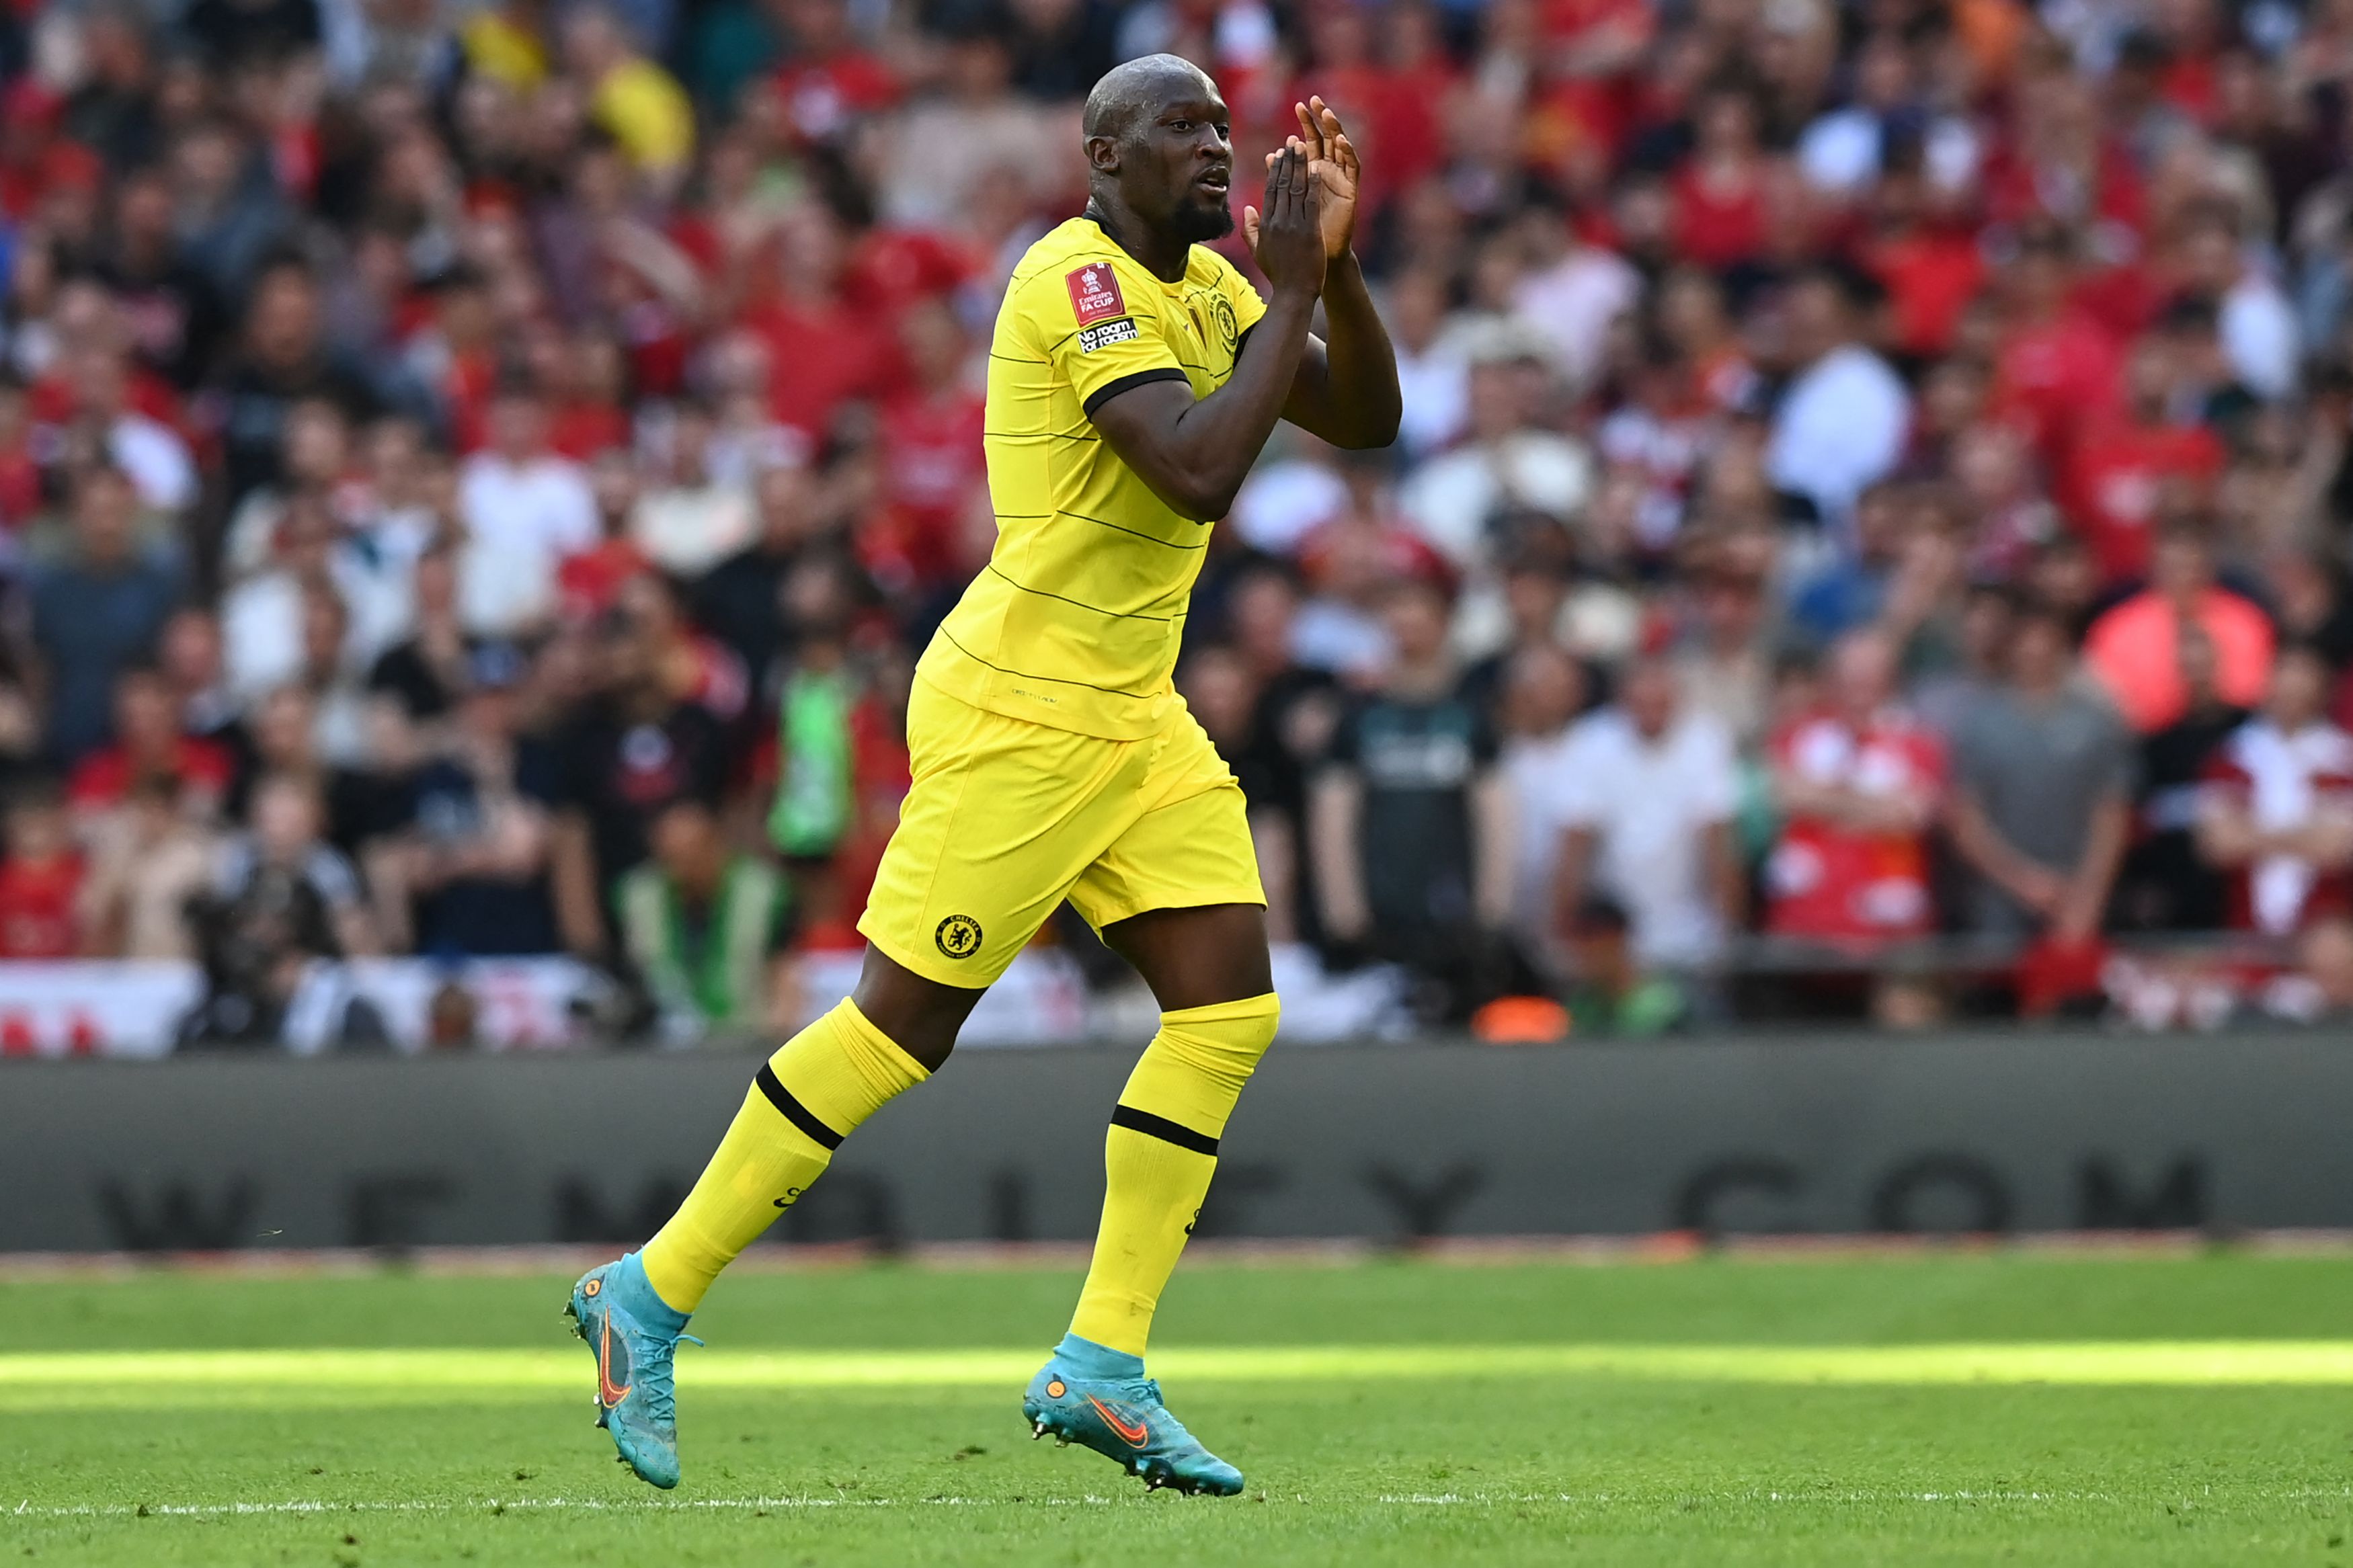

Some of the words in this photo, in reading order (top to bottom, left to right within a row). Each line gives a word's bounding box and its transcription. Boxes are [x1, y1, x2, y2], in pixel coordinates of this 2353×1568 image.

[1078, 292, 1112, 305] Emirates
[1080, 303, 1094, 313] FA
[1094, 297, 1114, 308] CUP
[1078, 330, 1096, 343] No
[1096, 321, 1129, 337] room
[950, 915, 980, 932] CHELSEA
